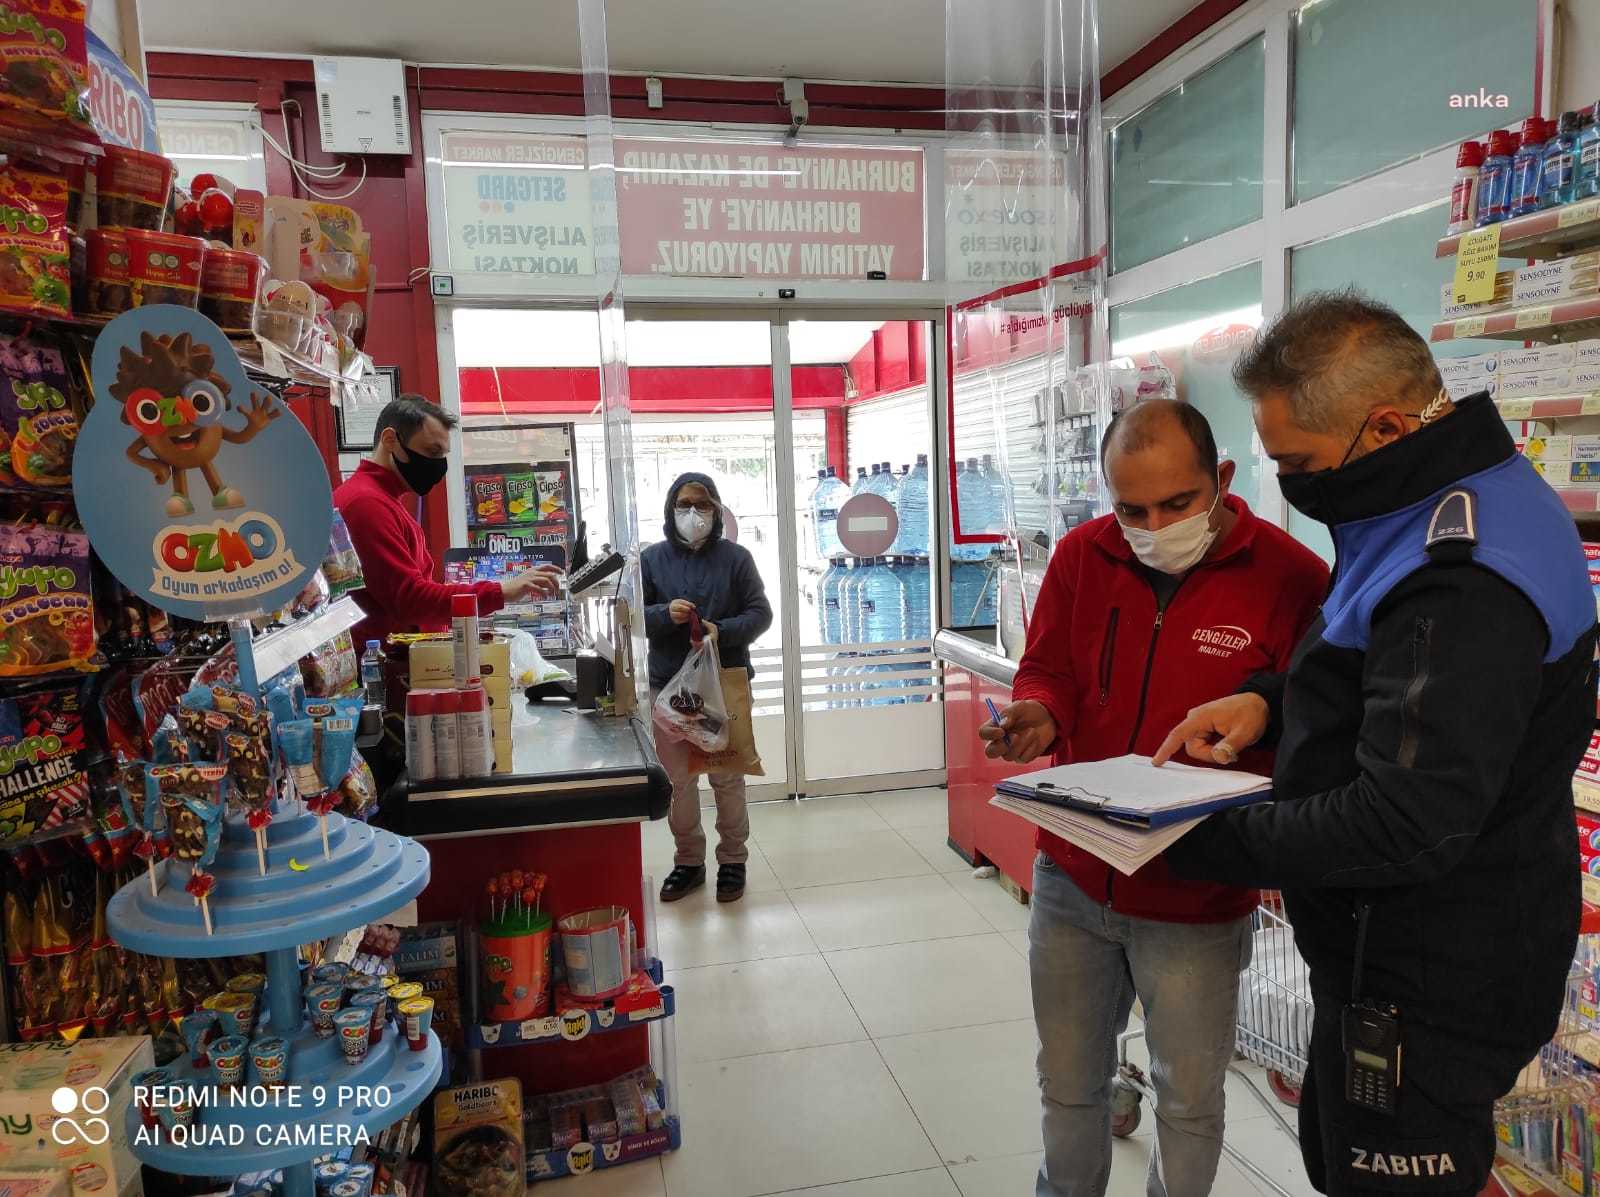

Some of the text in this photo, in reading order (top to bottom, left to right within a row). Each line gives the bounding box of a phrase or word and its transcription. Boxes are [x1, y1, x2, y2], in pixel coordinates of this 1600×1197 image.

[88, 58, 145, 150] RIBO
[1519, 267, 1564, 282] SENSODYNE
[1517, 286, 1561, 300] SENSODYNE
[160, 519, 277, 573] OZMO
[162, 576, 199, 596] Oyun
[278, 558, 294, 576] o!
[1191, 628, 1248, 651] CENGİZLER
[1198, 644, 1233, 658] MARKET
[0, 755, 77, 798] HALLENGE
[1351, 1147, 1456, 1177] ZABITA
